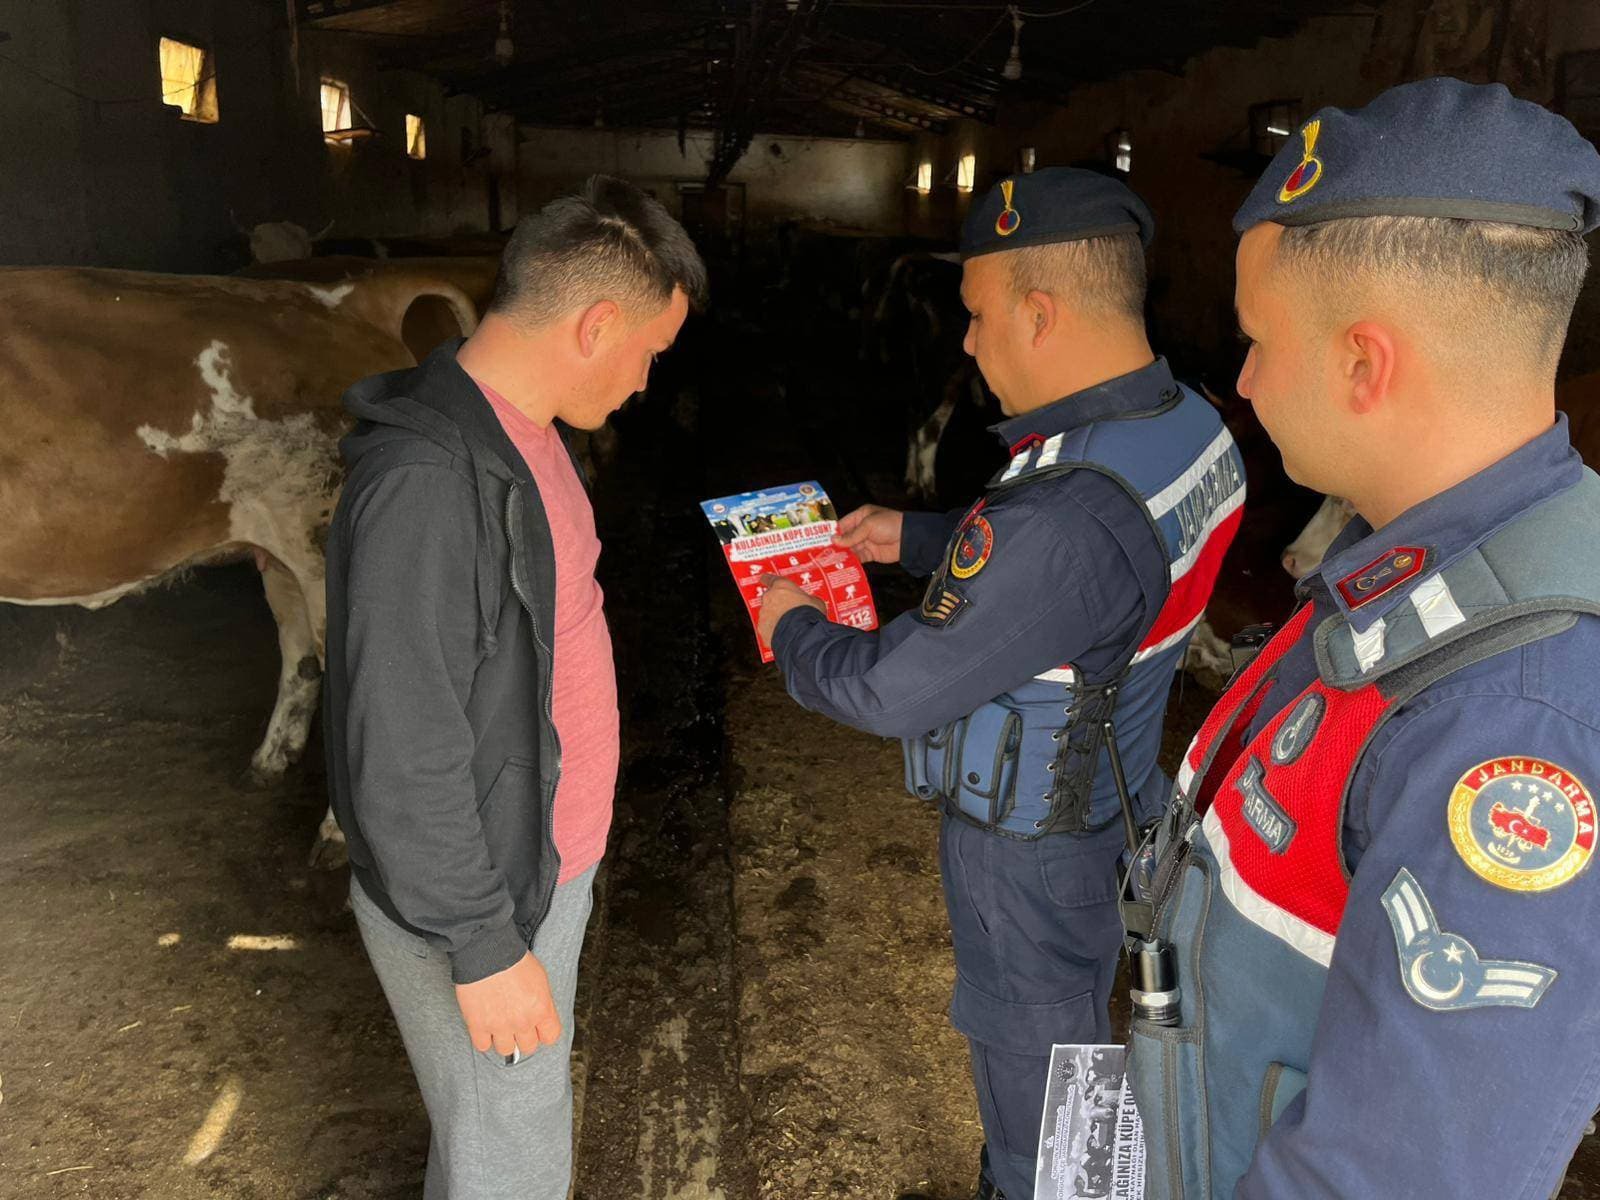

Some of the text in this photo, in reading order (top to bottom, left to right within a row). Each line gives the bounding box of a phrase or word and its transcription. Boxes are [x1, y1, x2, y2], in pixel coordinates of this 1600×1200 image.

[849, 610, 871, 625] 112
[1479, 760, 1594, 834] JANDARMA
[1118, 1108, 1136, 1141] KÜPE
